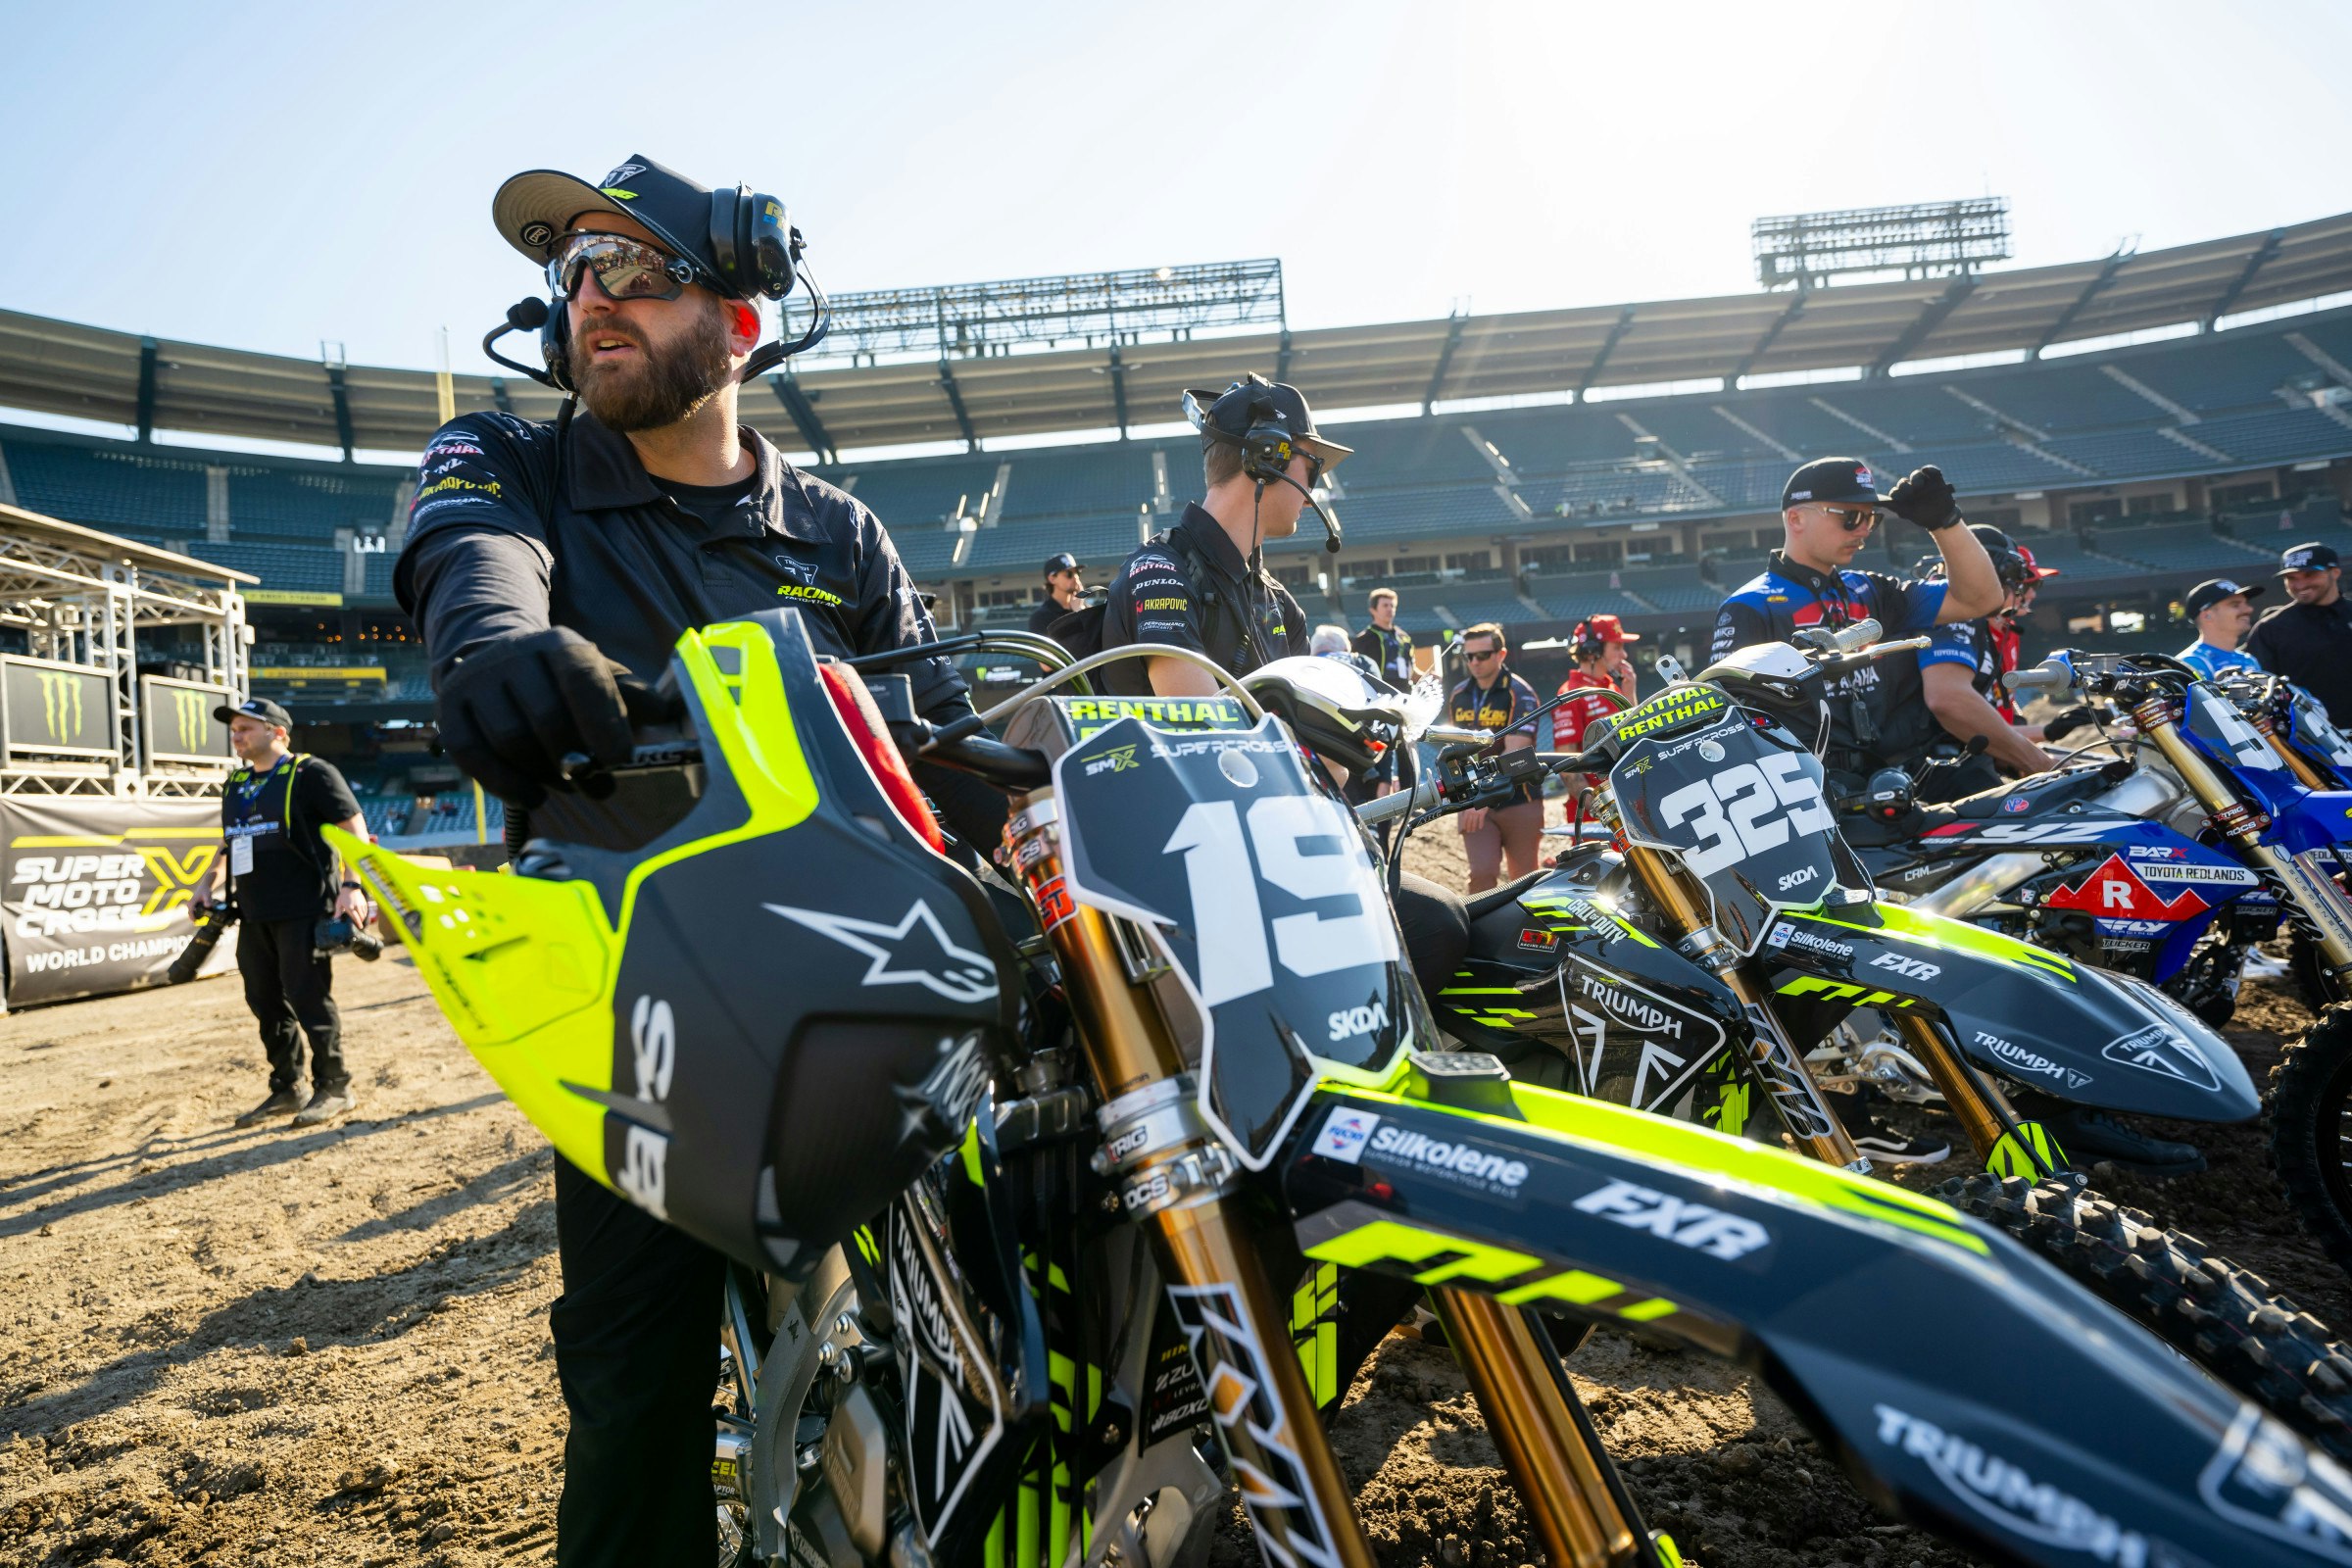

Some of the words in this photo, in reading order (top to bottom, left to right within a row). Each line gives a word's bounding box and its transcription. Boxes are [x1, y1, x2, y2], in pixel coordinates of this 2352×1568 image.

[777, 585, 843, 606] RACING
[1069, 701, 1240, 723] RENTHAL
[1618, 696, 1725, 742] RENTHAL
[1150, 740, 1291, 760] SUPERCROSS
[1657, 722, 1745, 760] SUPERCROSS
[1084, 748, 1141, 776] SMX
[1623, 758, 1654, 779] SMX
[1659, 751, 1838, 879] 325
[11, 854, 146, 884] SUPER
[1778, 865, 1819, 892] SKDA
[2143, 866, 2183, 879] TOYOTA
[2186, 867, 2245, 881] REDLANDS
[22, 879, 141, 910] MOTO
[1161, 795, 1400, 1007] 19
[2102, 879, 2135, 909] R
[1568, 899, 1592, 922] CALL
[1591, 915, 1628, 946] DUTY
[25, 945, 106, 973] WORLD
[108, 934, 195, 961] CHAMPIO
[1790, 931, 1854, 956] Silkolene
[2102, 937, 2151, 950] TUCKER
[1868, 951, 1942, 982] FXR
[1327, 1002, 1391, 1042] SKDA
[1581, 974, 1684, 1041] TRIUMPH
[1973, 1031, 2066, 1079] TRIUMPH
[1369, 1126, 1530, 1187] Silkolene
[1571, 1176, 1771, 1261] FXR
[898, 1207, 965, 1391] TRIUMPH
